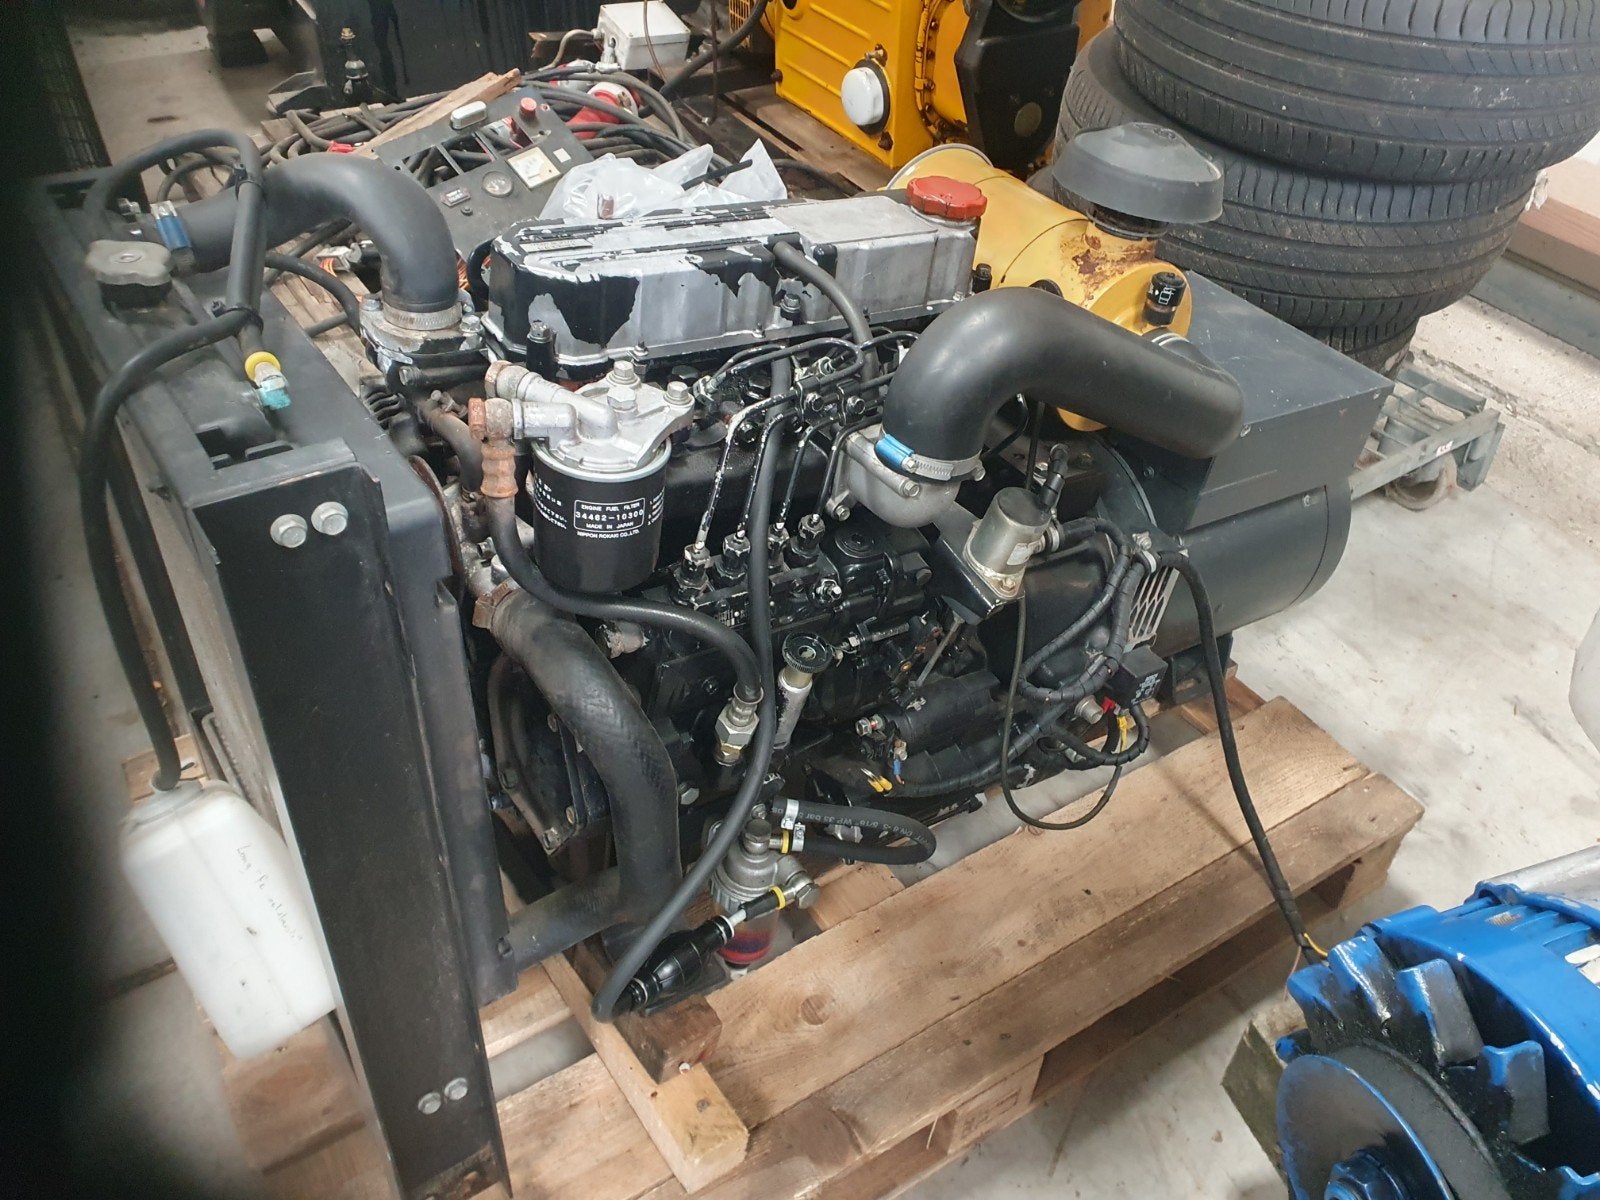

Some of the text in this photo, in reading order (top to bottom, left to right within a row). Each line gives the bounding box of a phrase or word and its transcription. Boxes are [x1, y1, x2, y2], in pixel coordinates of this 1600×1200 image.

[623, 502, 640, 510] FILTER
[616, 521, 634, 529] JAPAN
[576, 530, 598, 538] NIPPON
[805, 813, 822, 821] bar
